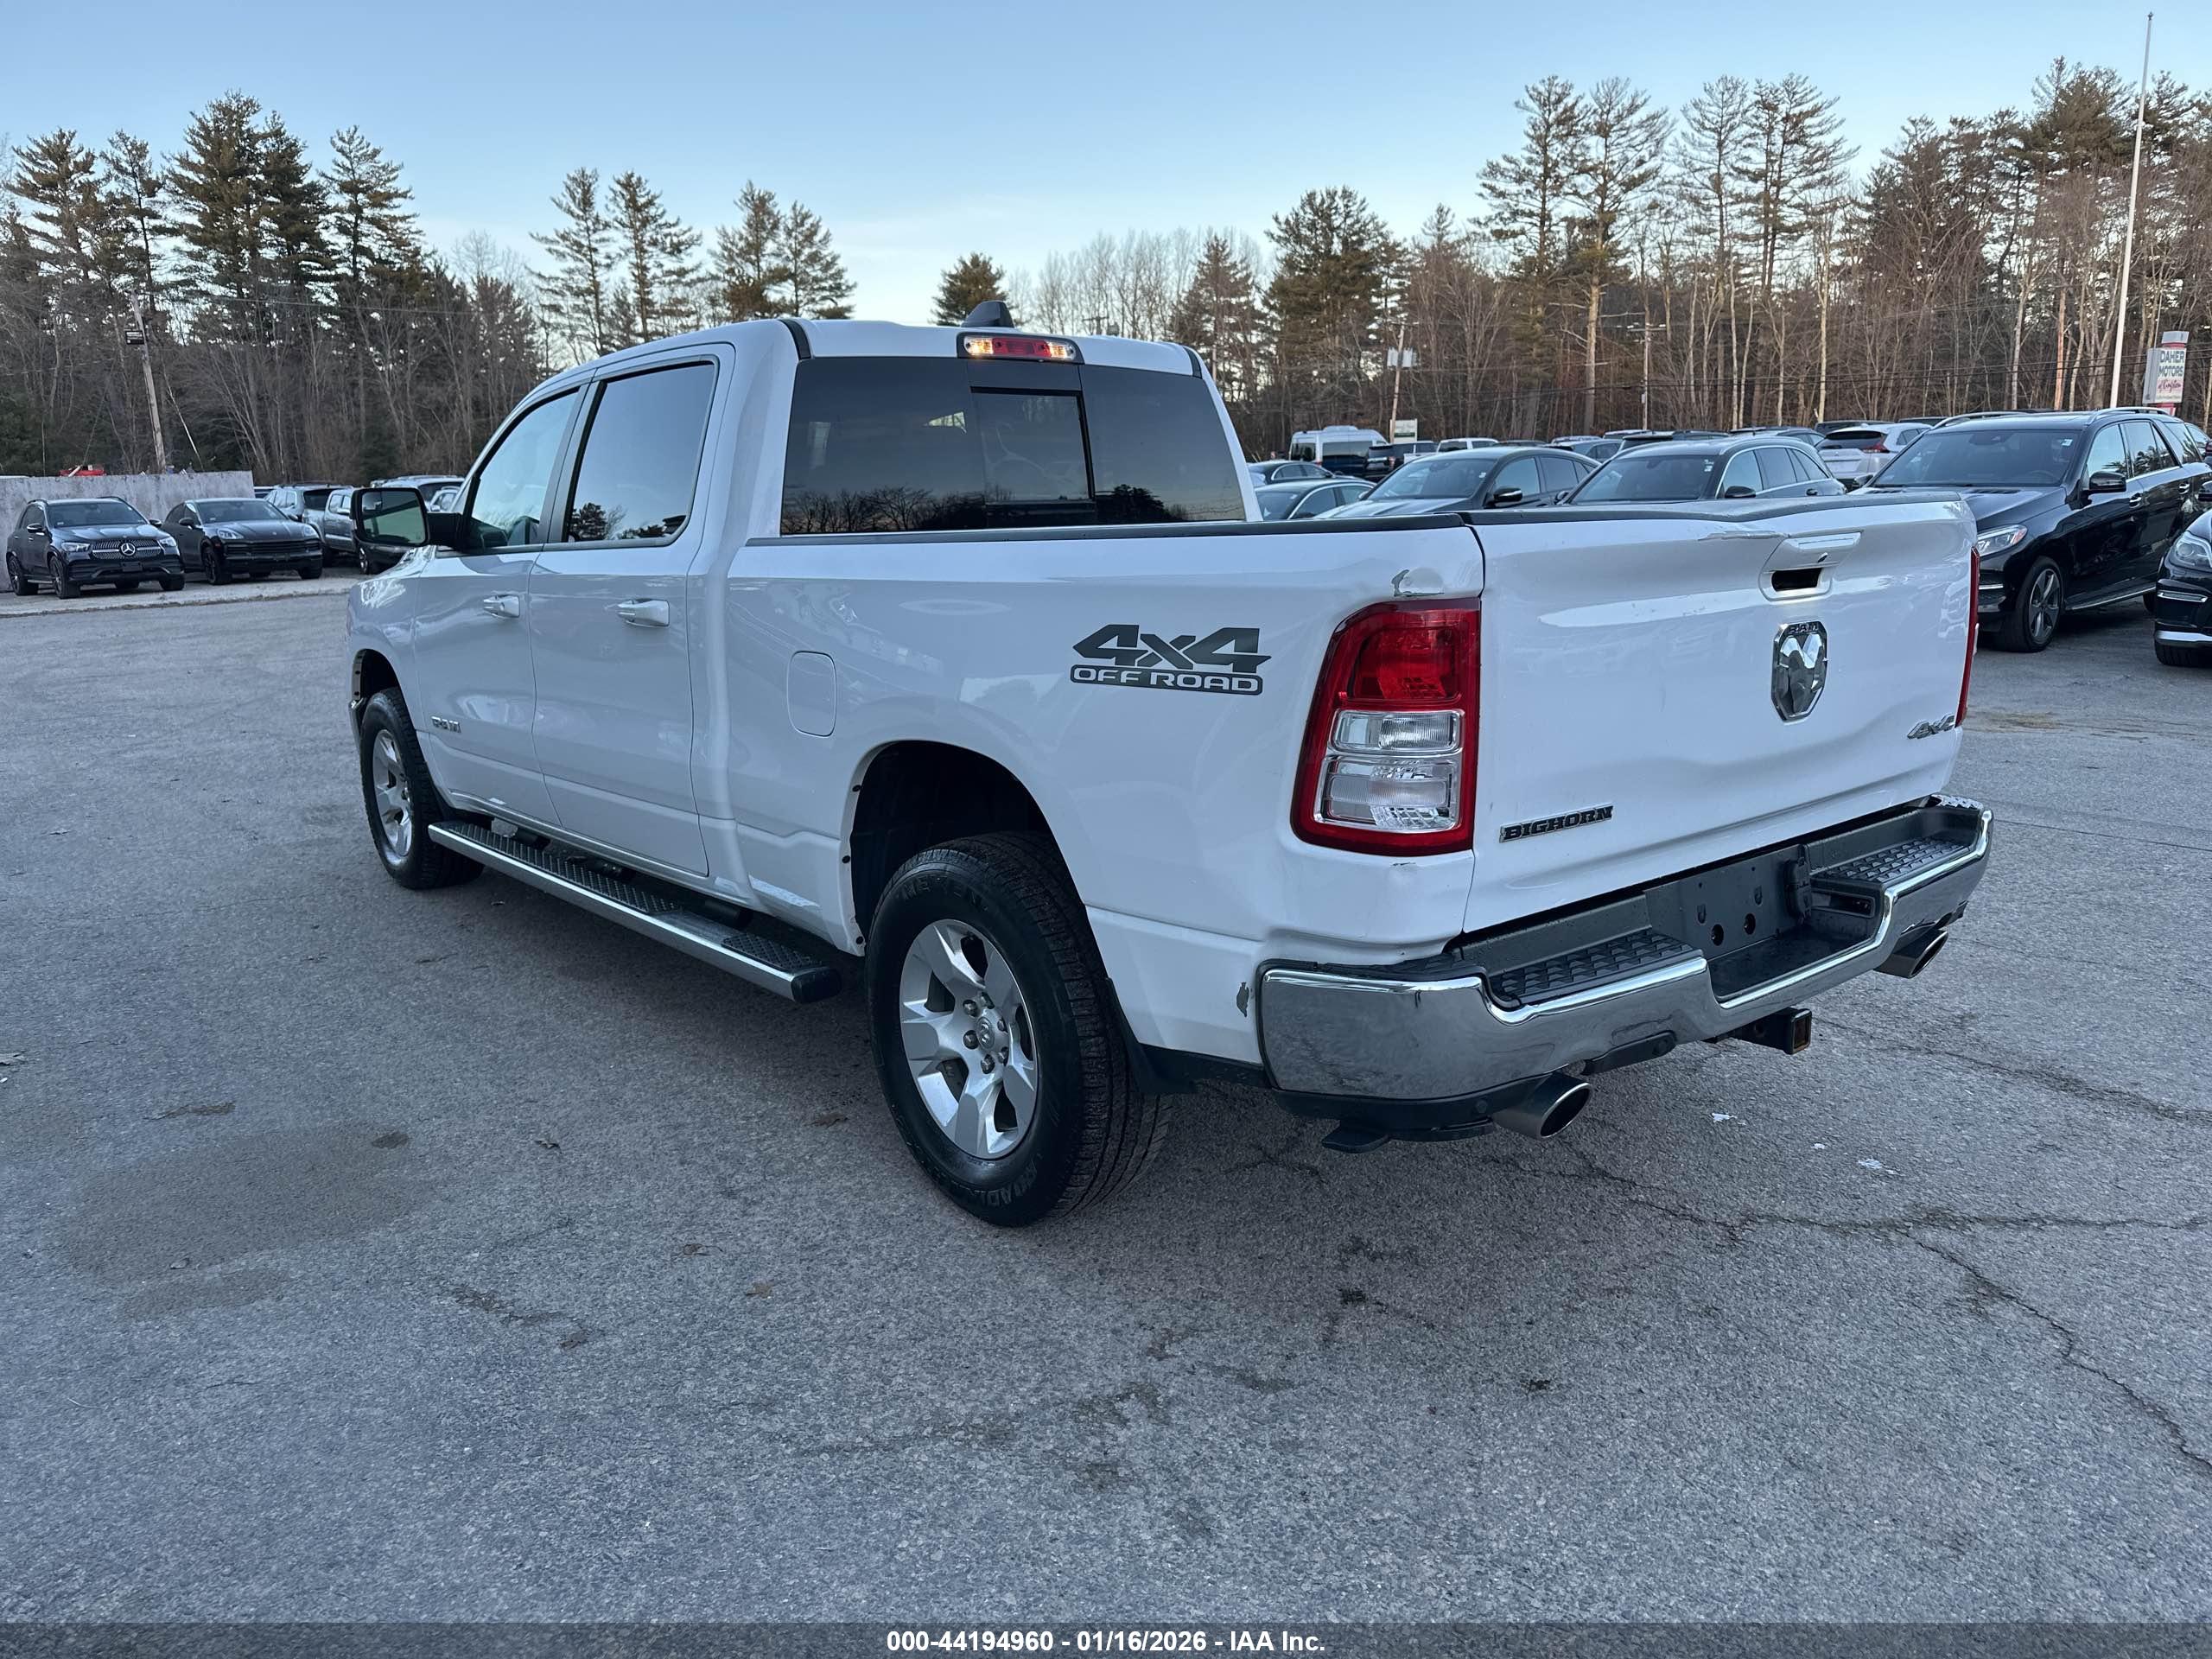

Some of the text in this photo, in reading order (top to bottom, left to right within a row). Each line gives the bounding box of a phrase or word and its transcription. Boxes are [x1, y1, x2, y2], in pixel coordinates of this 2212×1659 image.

[2160, 350, 2184, 363] DAHER
[2158, 365, 2183, 377] MOTORS
[1073, 667, 1259, 692] OFF ROAD
[1499, 804, 1614, 843] BIGHORN
